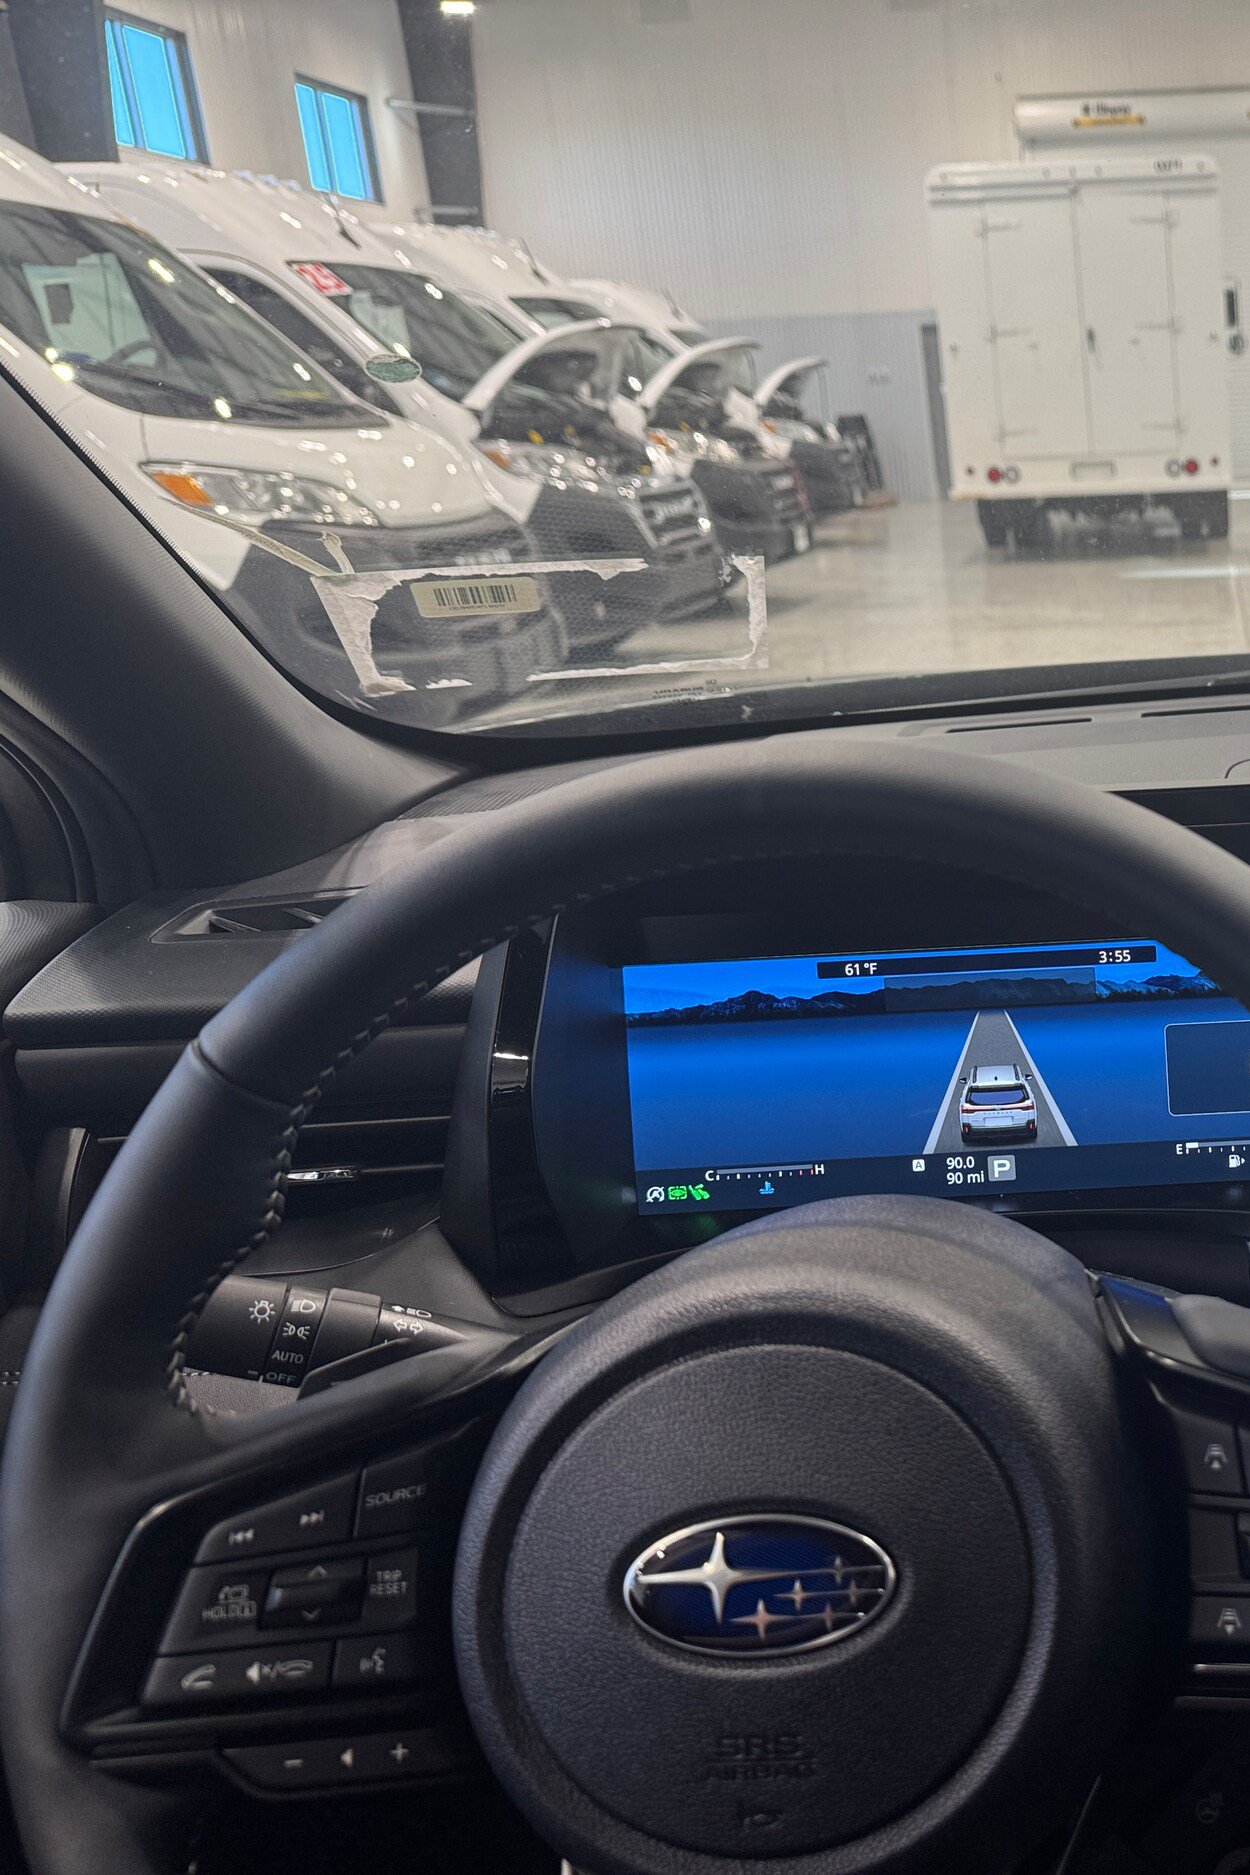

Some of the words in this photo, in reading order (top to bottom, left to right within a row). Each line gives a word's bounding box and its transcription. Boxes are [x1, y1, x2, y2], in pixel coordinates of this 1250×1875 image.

[1098, 949, 1131, 963] 3:55
[1176, 1144, 1183, 1155] E
[814, 1164, 825, 1175] H
[946, 1156, 975, 1170] 90.0
[993, 1159, 1011, 1178] P
[704, 1170, 715, 1182] C
[946, 1172, 964, 1185] 90
[967, 1170, 985, 1183] mi
[271, 1350, 304, 1364] AUTO
[265, 1371, 297, 1384] OFF
[365, 1484, 428, 1509] SOURCE
[376, 1569, 403, 1582] TRIP
[370, 1581, 409, 1595] RESET
